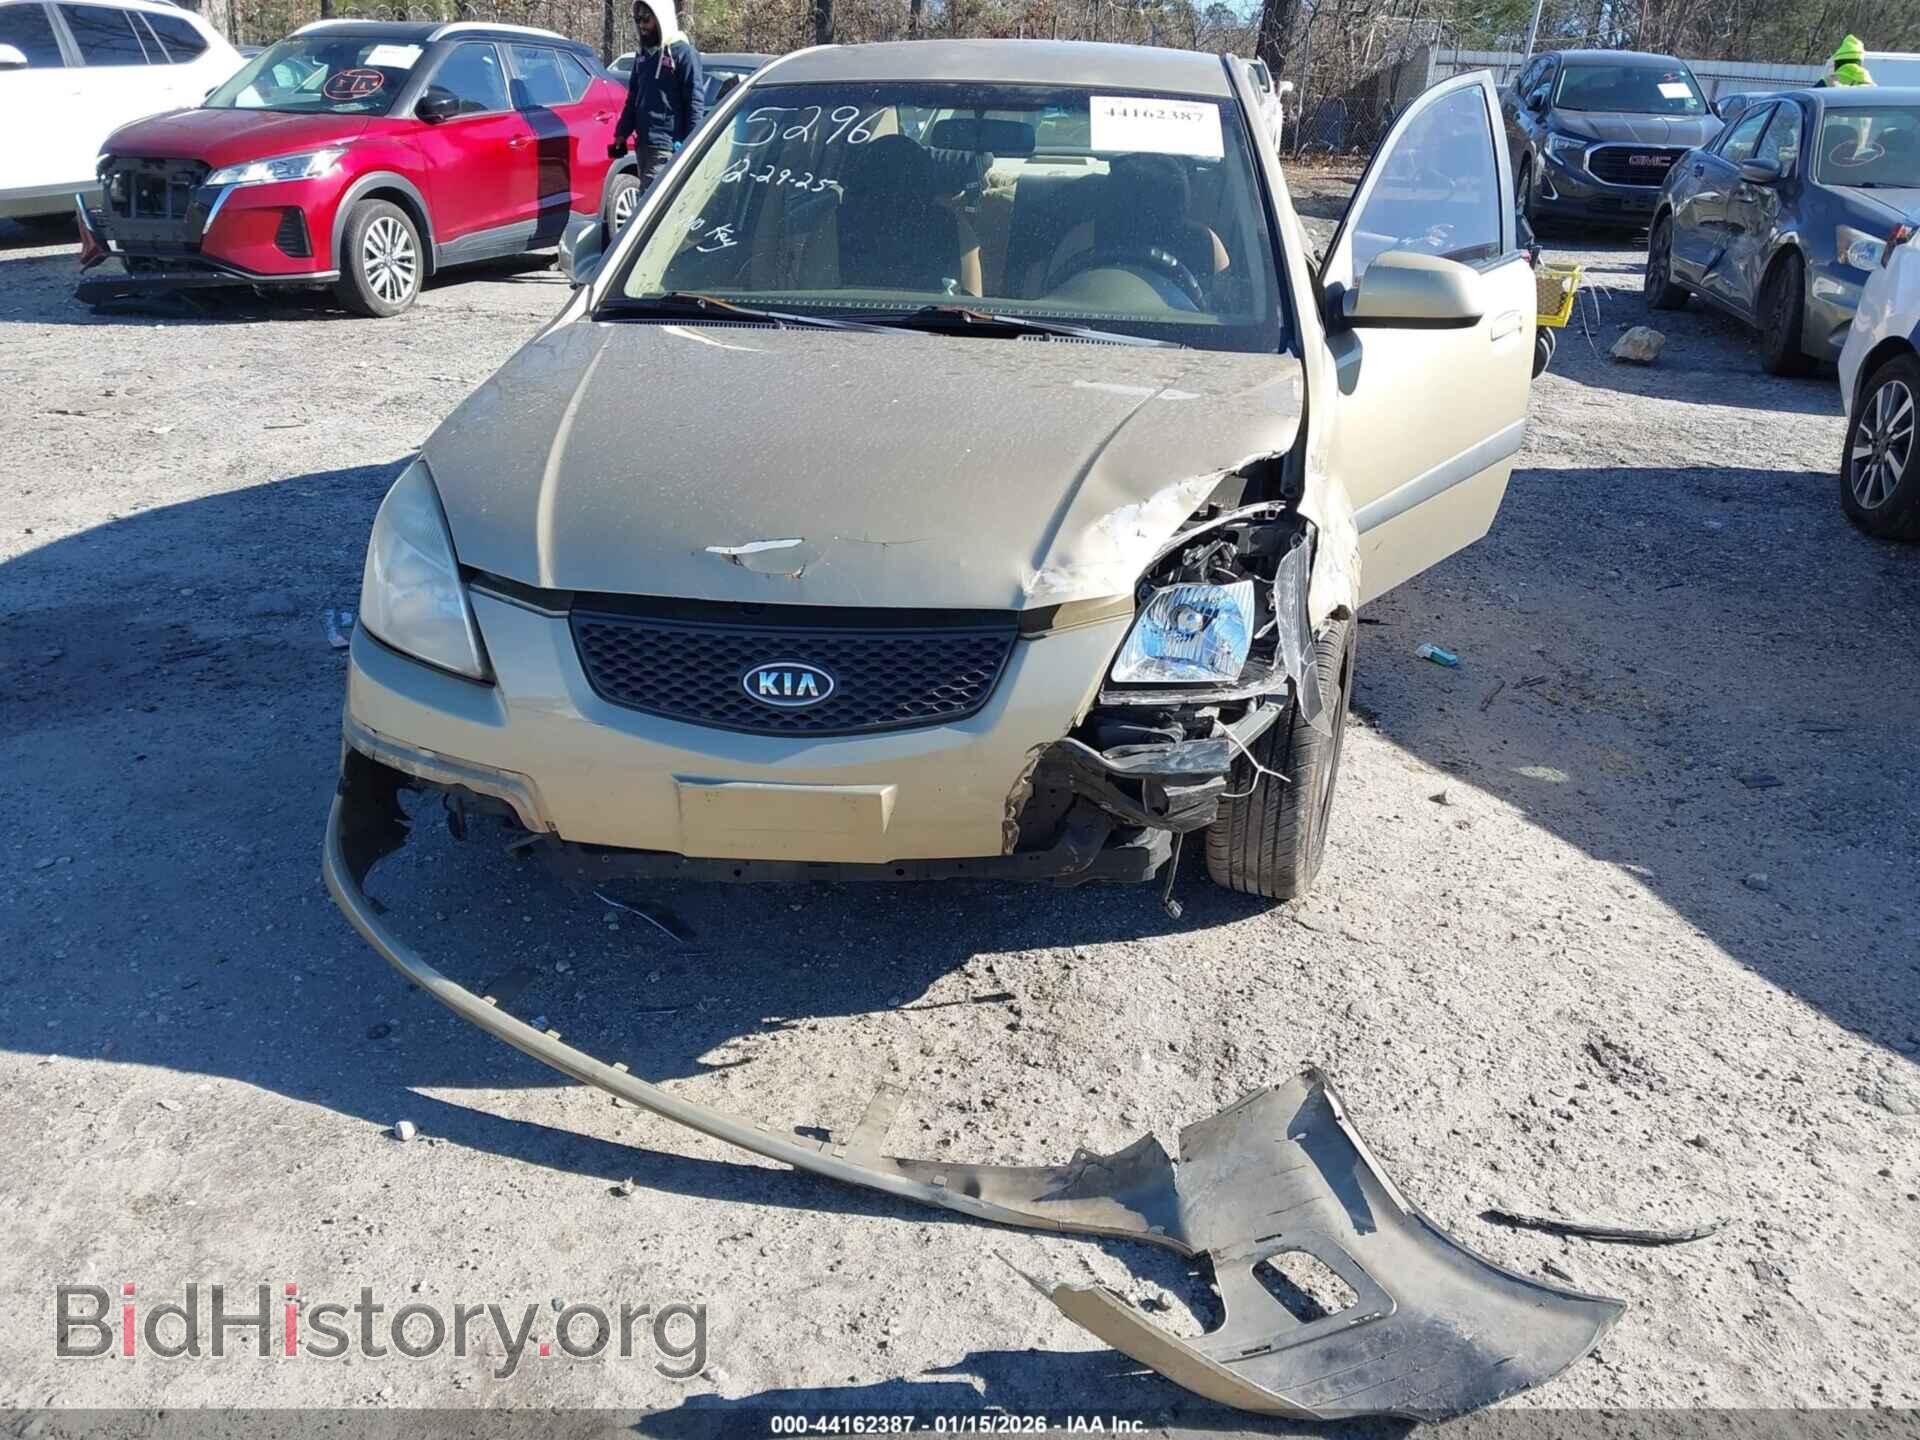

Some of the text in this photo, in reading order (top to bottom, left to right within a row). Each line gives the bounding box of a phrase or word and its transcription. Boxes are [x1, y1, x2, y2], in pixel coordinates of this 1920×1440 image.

[1105, 107, 1203, 122] 44162387
[731, 105, 889, 147] 5296
[1629, 155, 1671, 167] GMC
[759, 671, 819, 697] KIA
